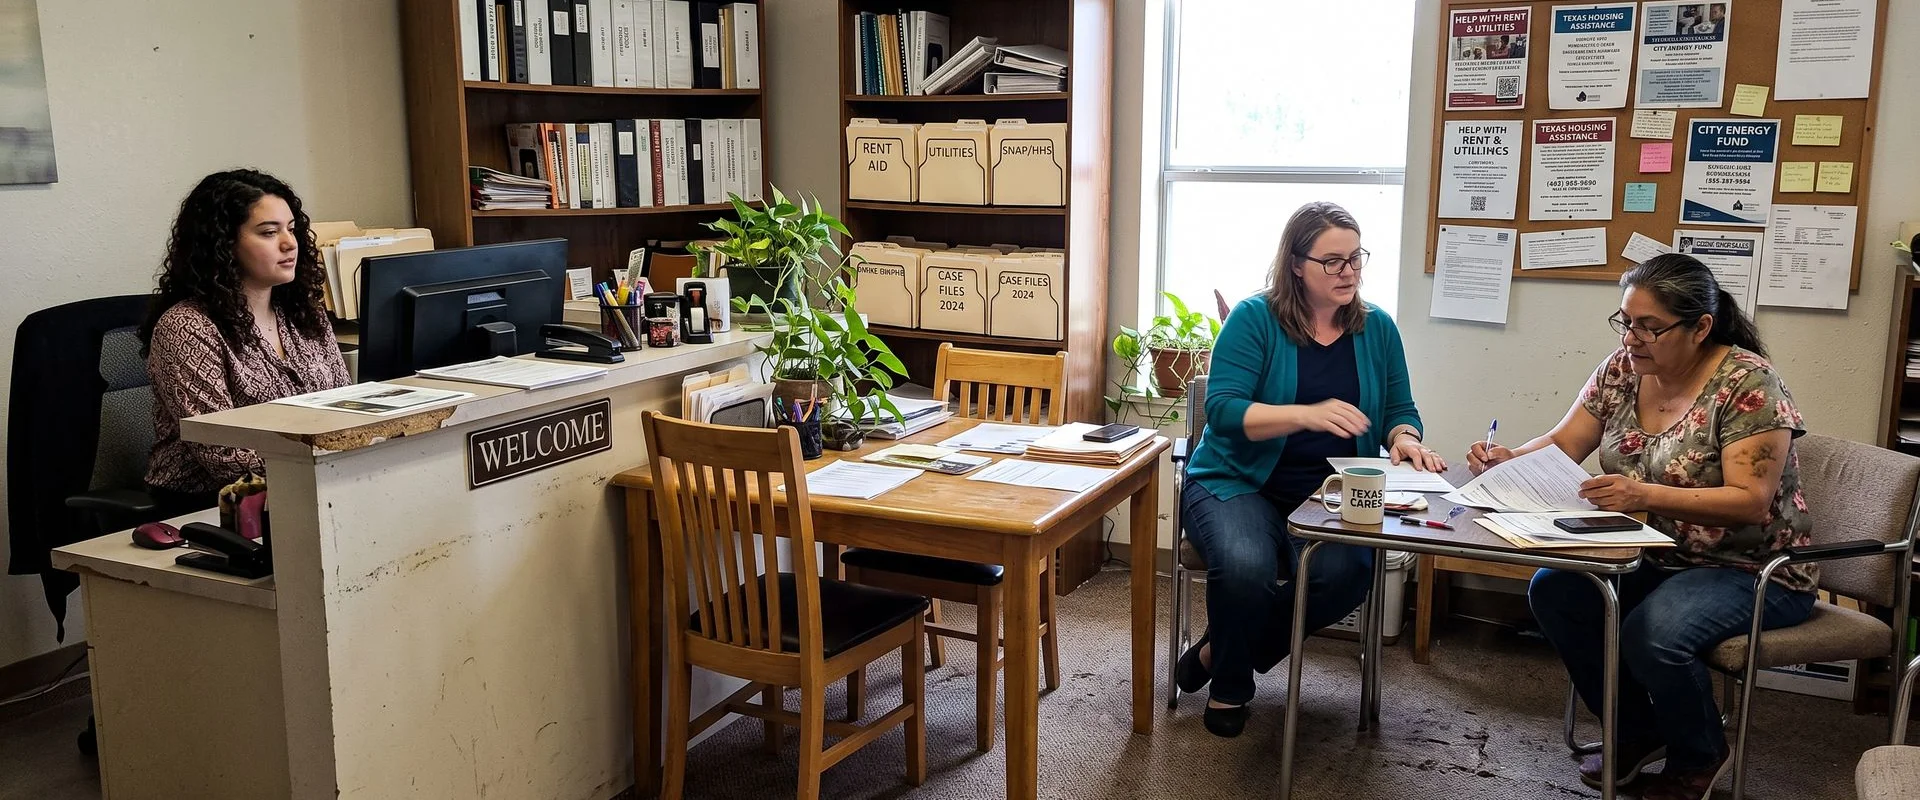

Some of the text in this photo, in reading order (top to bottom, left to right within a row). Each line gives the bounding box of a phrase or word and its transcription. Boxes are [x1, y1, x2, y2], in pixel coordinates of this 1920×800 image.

[1455, 12, 1527, 24] HELP WITH RENT
[1563, 12, 1624, 22] TEXAS HOUSING
[1466, 23, 1515, 33] & UTILITIES
[1570, 21, 1616, 30] ASSISTANCE
[1458, 126, 1507, 134] HELP WITH
[1541, 123, 1607, 133] TEXAS HOUSING
[1698, 126, 1771, 135] CITY ENERGY
[1462, 136, 1502, 145] RENT &
[1549, 132, 1598, 141] ASSISTANCE
[1717, 137, 1749, 146] FUND
[863, 142, 892, 155] RENT
[929, 147, 974, 158] UTILITIES
[1002, 145, 1052, 156] SNAP/HHS
[868, 160, 888, 172] AID
[938, 270, 964, 282] CASE
[1000, 275, 1048, 287] CASE FILES
[939, 285, 965, 297] FILES
[1012, 289, 1034, 300] 2024
[940, 300, 965, 311] 2024
[478, 411, 605, 472] WELCOME
[1351, 488, 1382, 499] TEXAS
[1350, 498, 1382, 508] CARES
